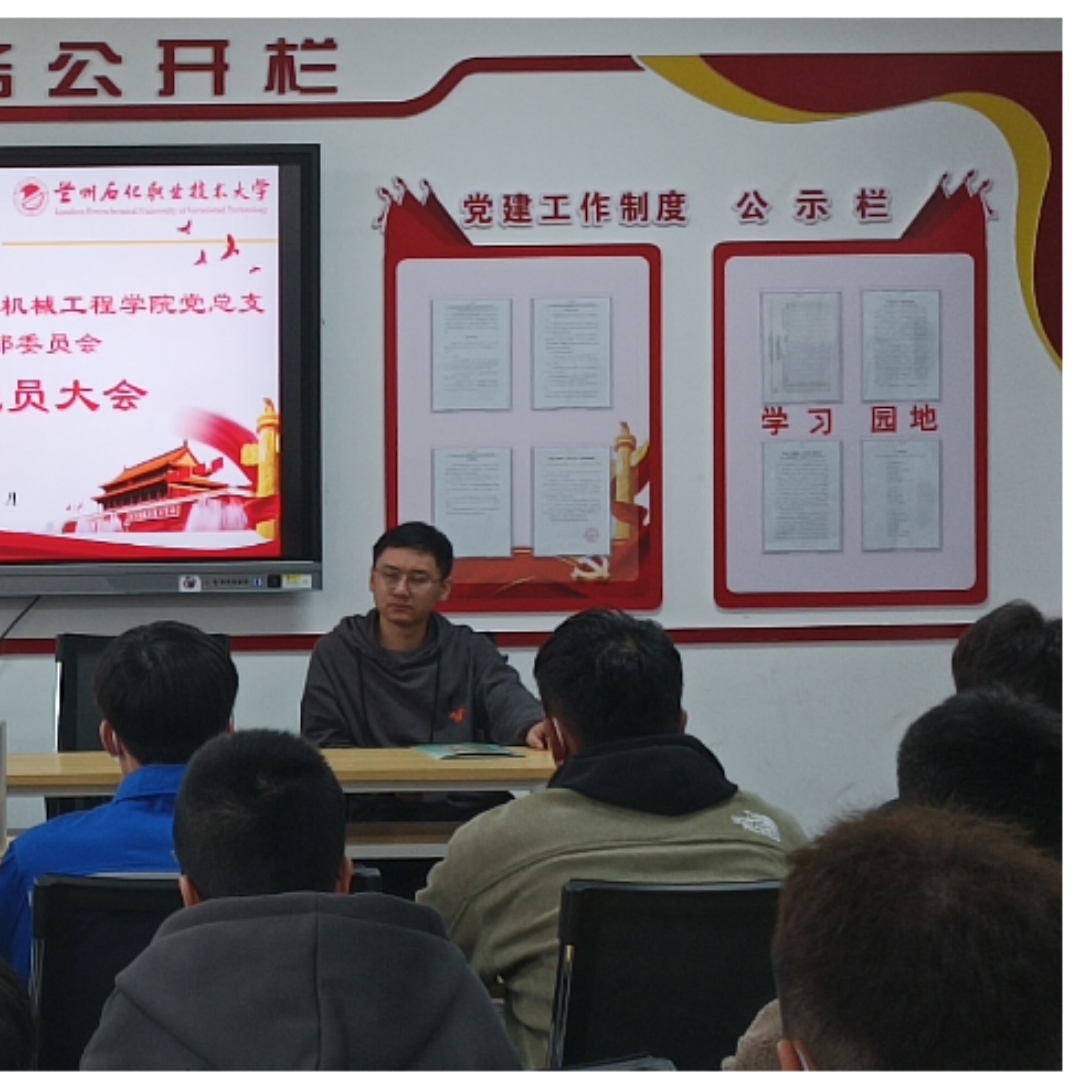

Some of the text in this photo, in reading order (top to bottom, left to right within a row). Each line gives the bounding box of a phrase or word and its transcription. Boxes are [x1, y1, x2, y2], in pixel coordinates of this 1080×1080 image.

[54, 179, 270, 203] 兰州石化职业技术大学
[461, 190, 690, 227] 党建工作制度
[736, 187, 895, 223] 公示栏
